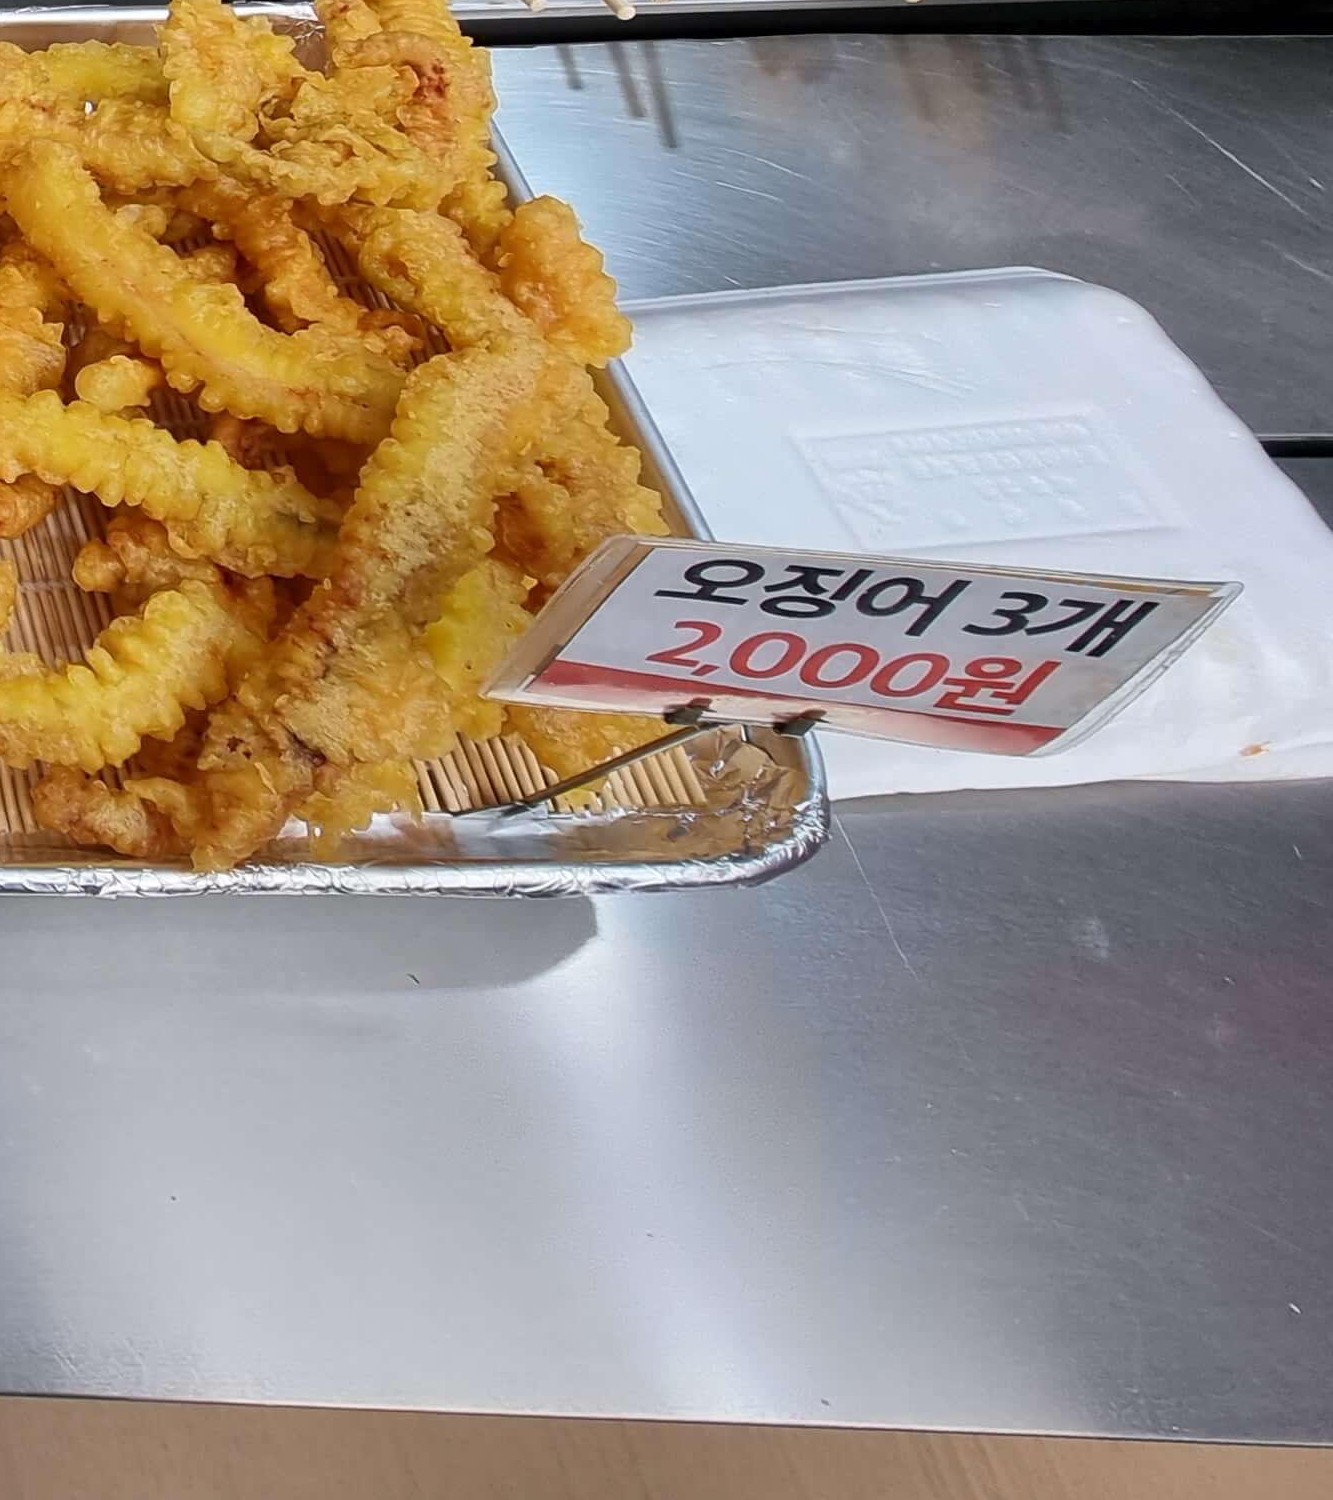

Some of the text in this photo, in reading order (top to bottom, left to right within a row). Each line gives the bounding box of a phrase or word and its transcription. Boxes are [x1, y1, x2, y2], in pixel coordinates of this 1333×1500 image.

[655, 558, 1162, 657] 오징어 3개
[645, 621, 1061, 715] 2,000원
